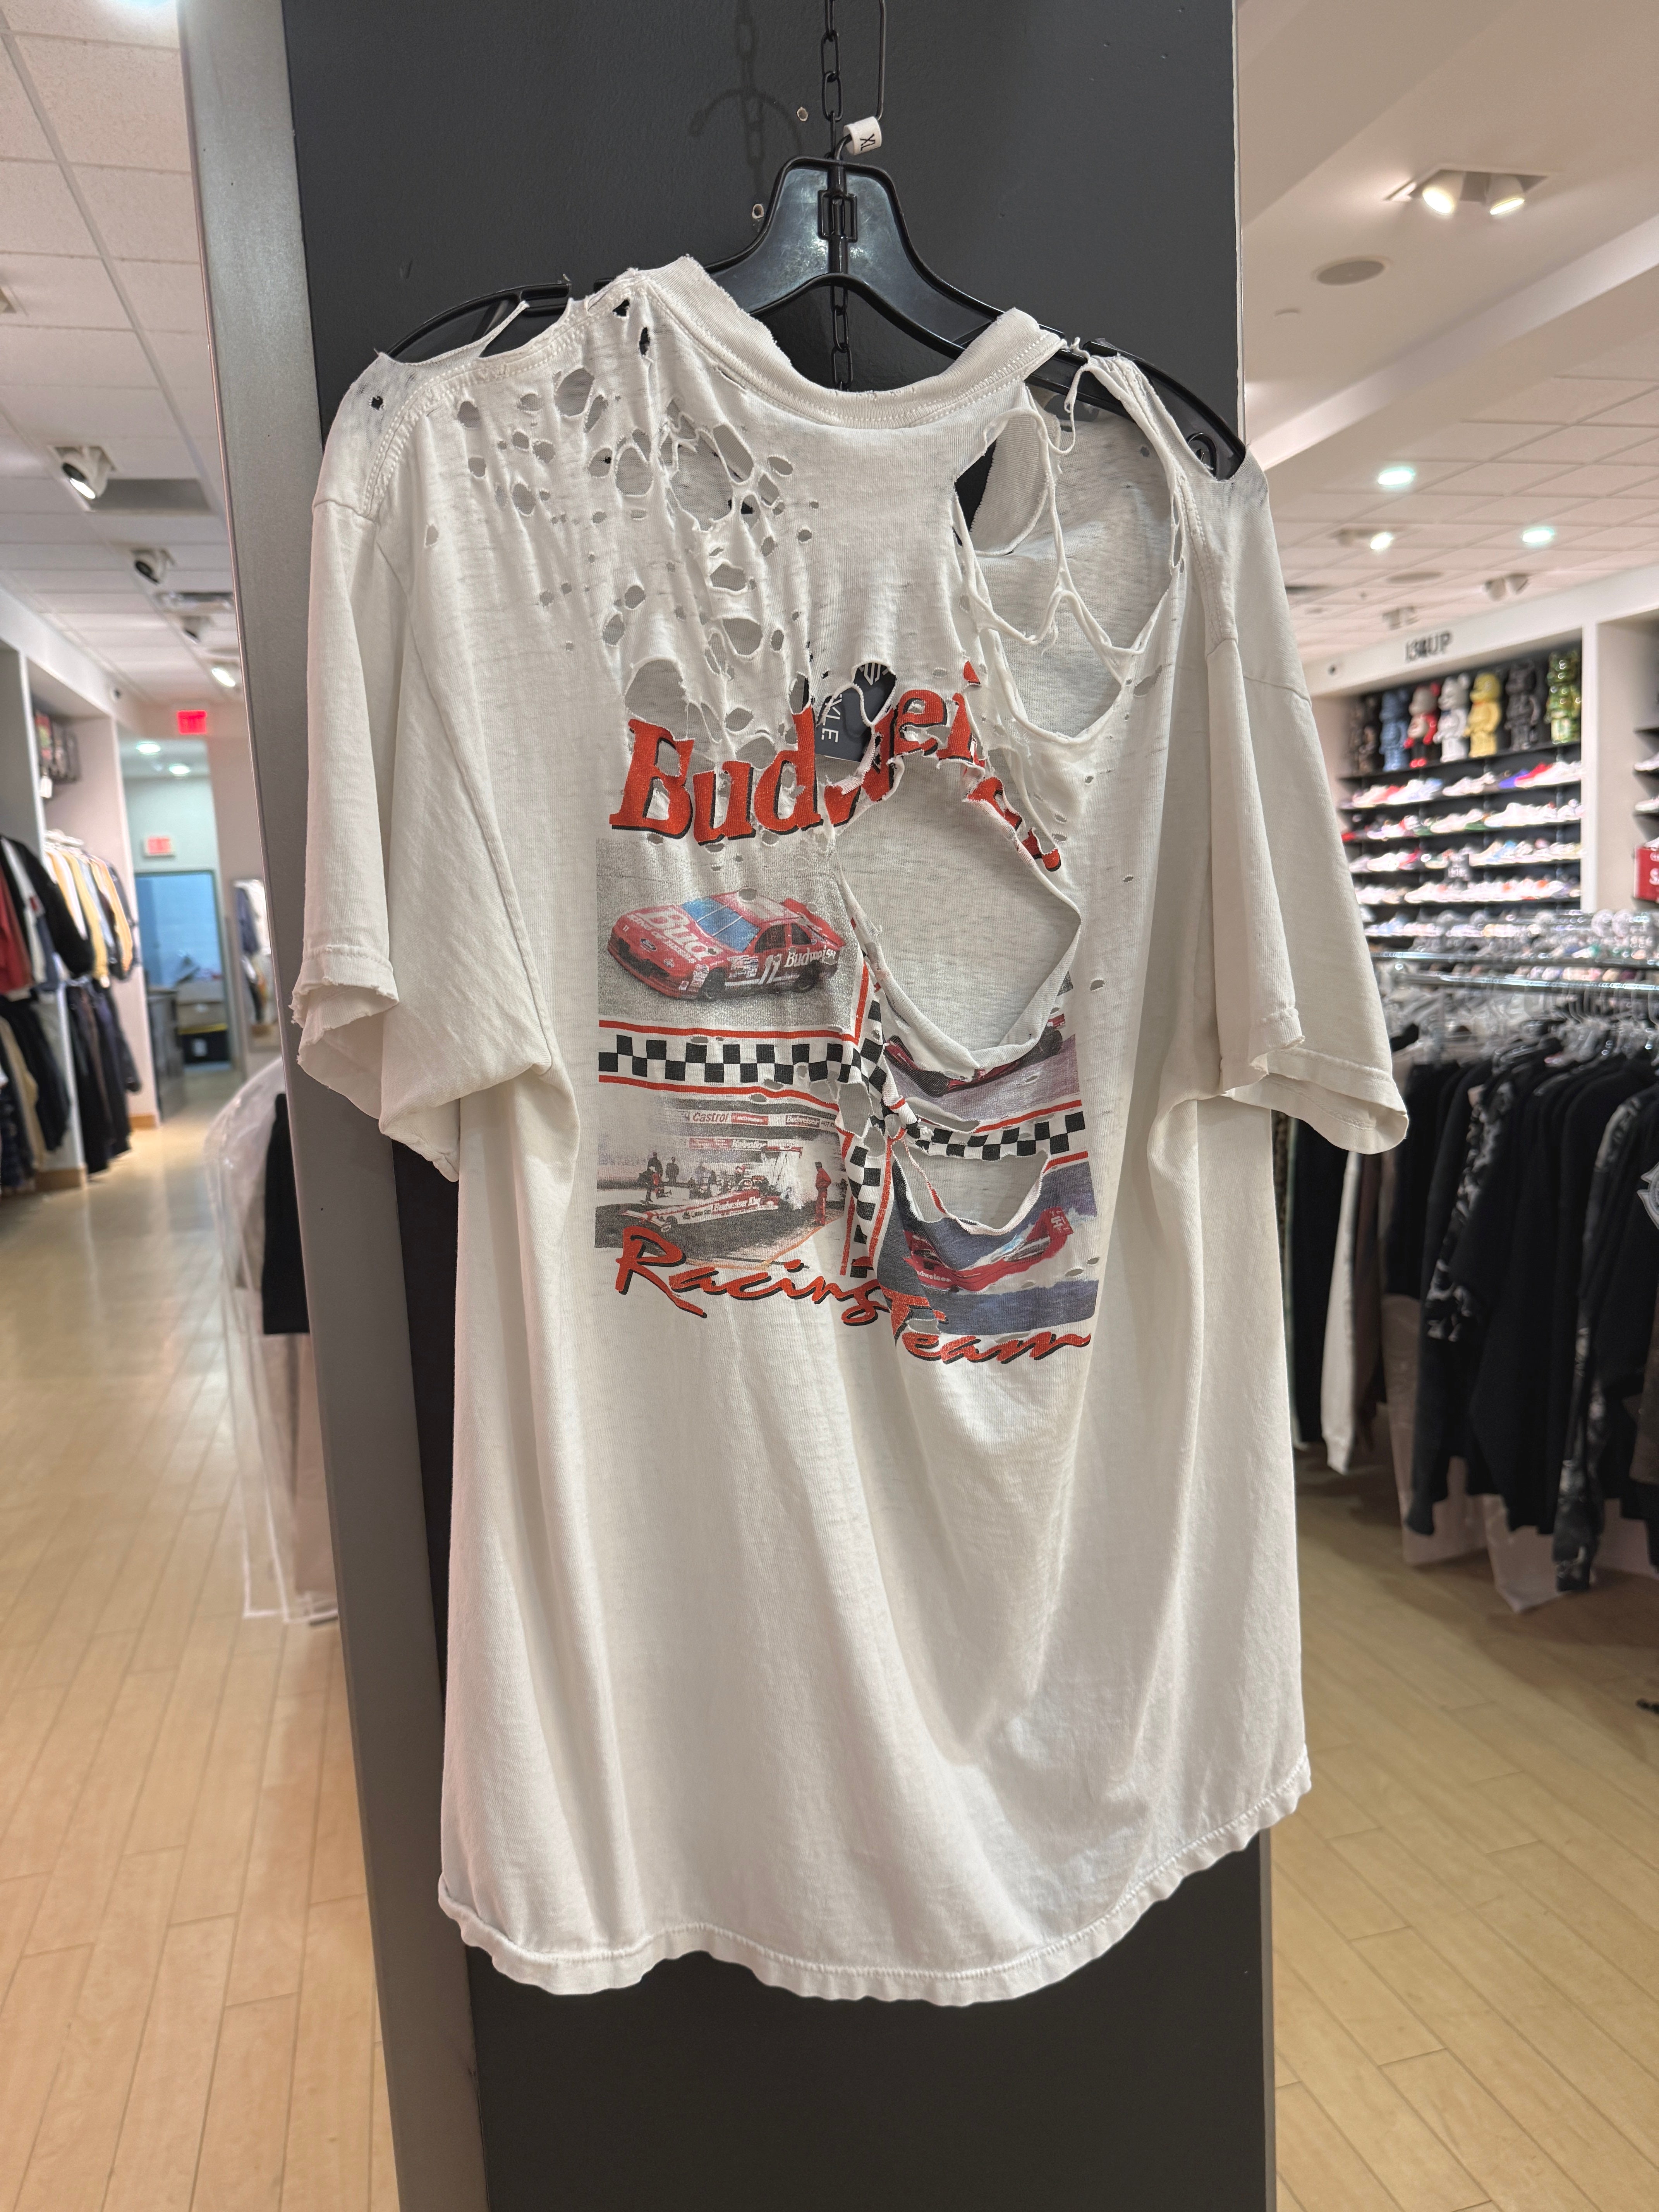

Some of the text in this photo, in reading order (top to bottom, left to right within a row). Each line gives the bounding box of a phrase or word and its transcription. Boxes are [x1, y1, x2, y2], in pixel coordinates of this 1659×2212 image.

[860, 134, 876, 151] XL
[821, 694, 843, 743] YLE
[692, 1112, 729, 1122] Castrol
[615, 1226, 1092, 1365] Racing Team
